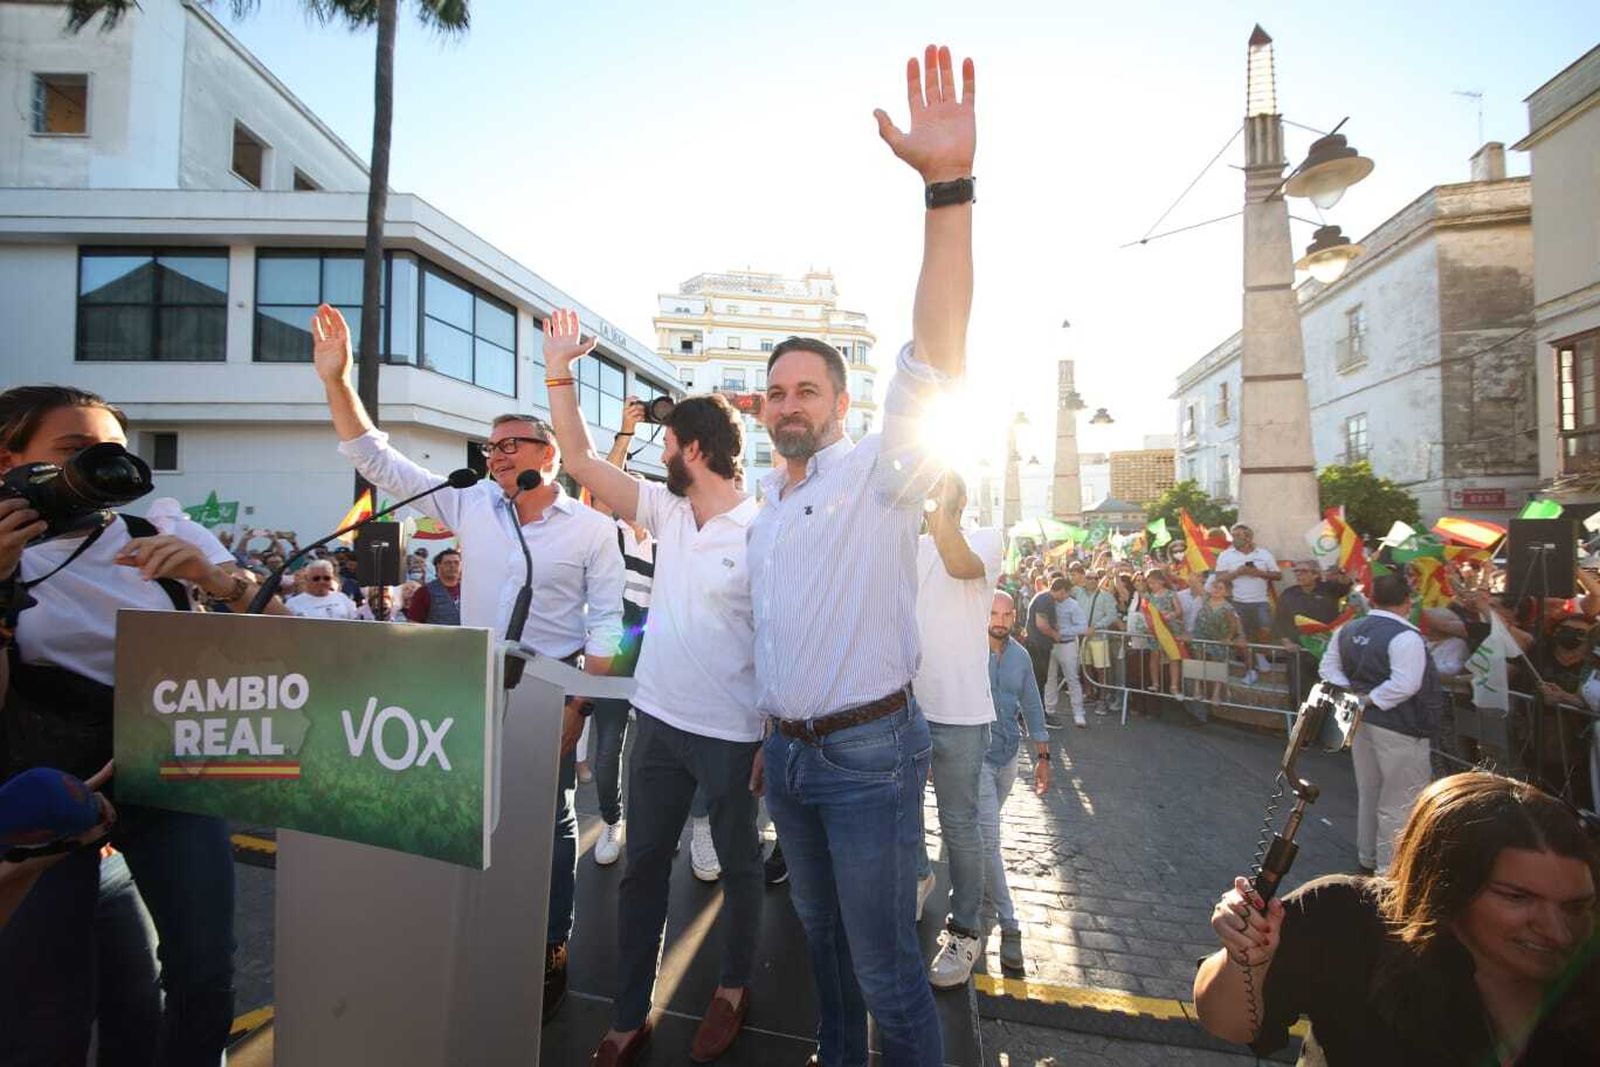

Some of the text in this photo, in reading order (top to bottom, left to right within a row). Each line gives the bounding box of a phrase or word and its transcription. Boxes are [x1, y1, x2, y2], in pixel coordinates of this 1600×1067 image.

[152, 672, 310, 714] CAMBIO
[174, 717, 285, 757] REAL
[341, 696, 455, 771] VOX
